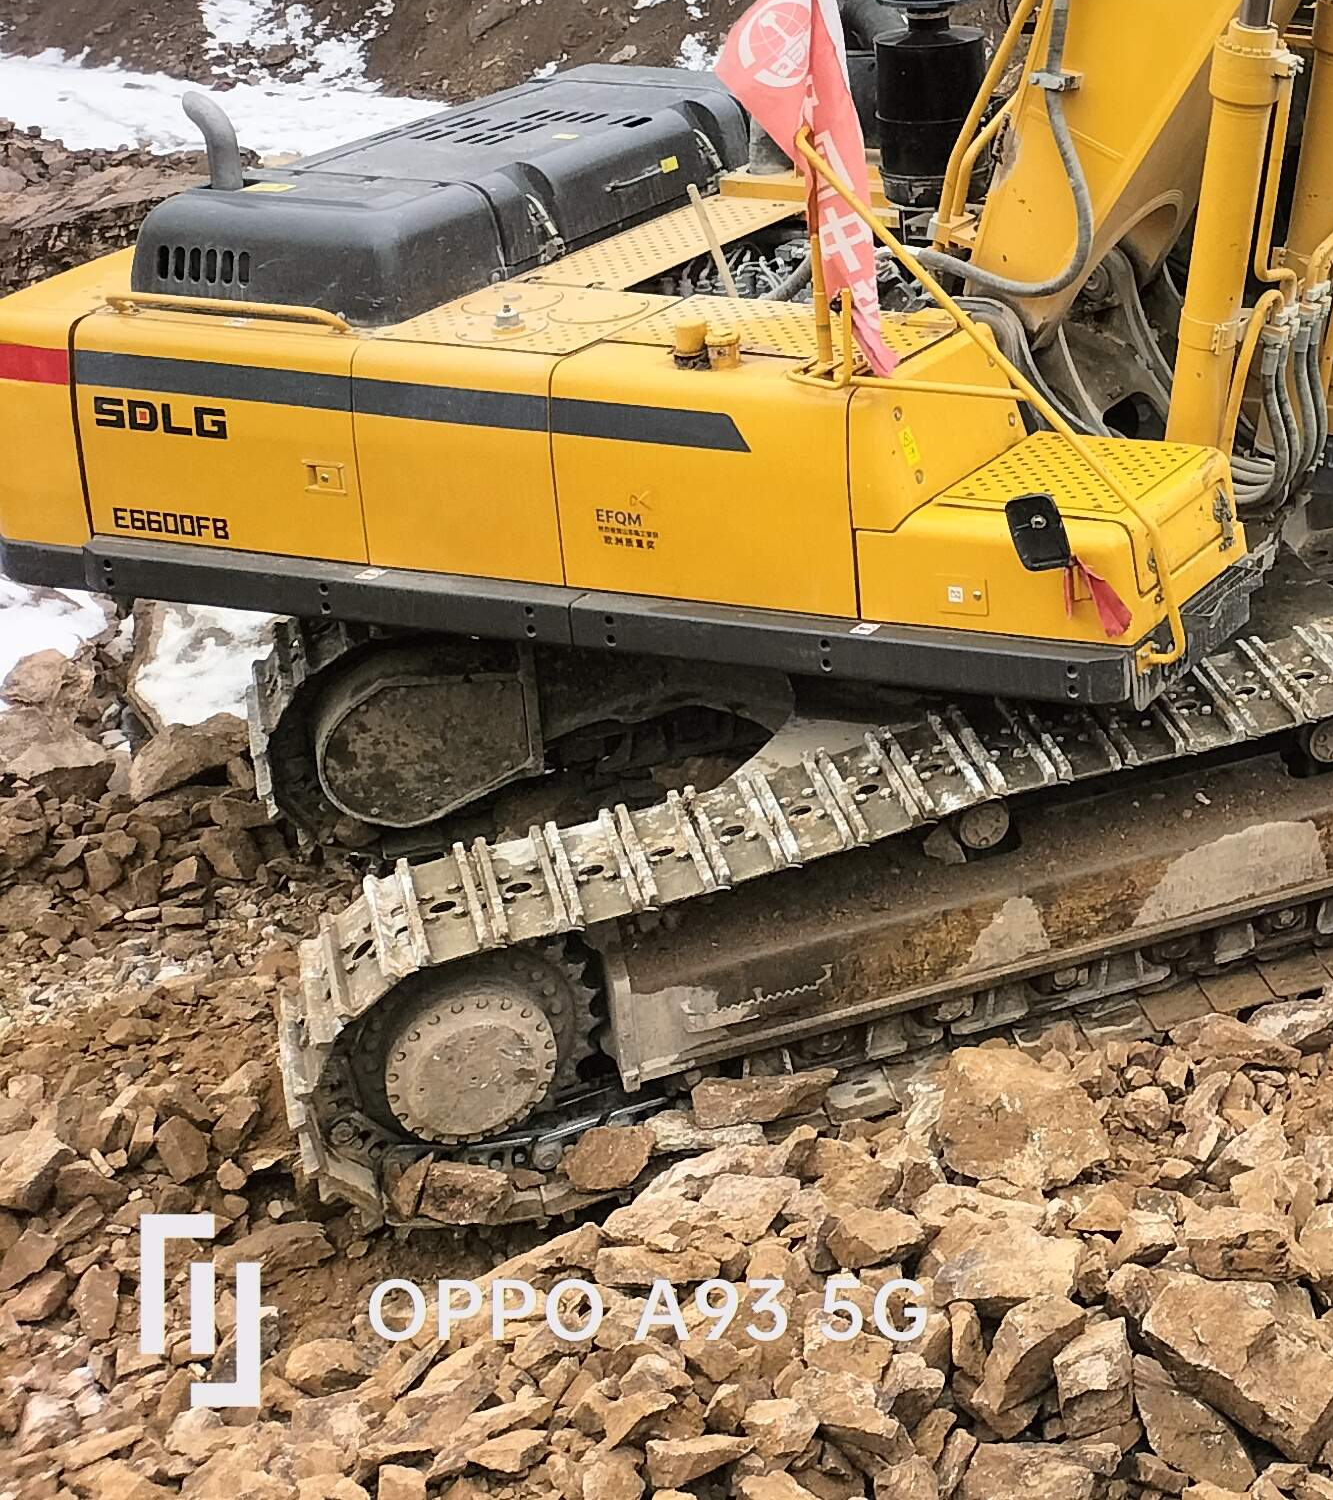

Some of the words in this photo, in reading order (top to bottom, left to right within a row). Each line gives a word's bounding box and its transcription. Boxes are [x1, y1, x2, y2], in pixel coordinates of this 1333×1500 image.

[94, 396, 228, 440] SDLG
[112, 507, 230, 540] E6600FB
[595, 508, 642, 526] EFQM
